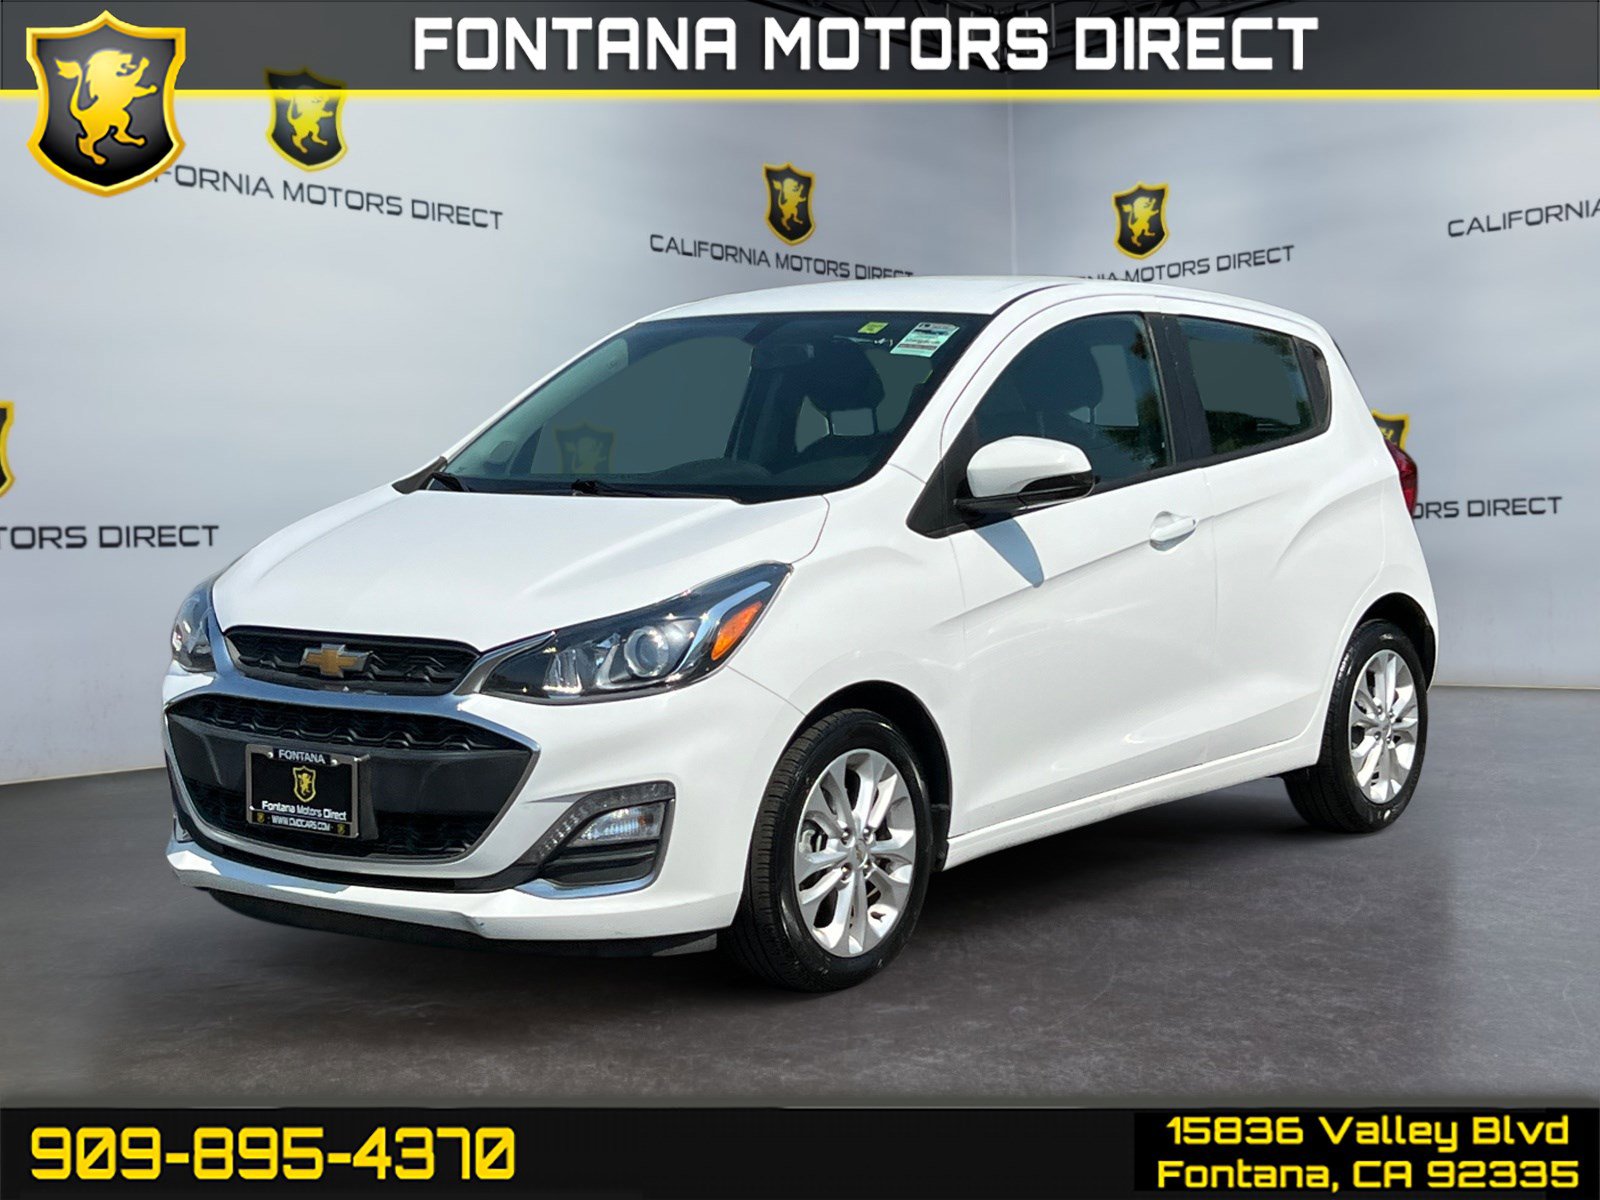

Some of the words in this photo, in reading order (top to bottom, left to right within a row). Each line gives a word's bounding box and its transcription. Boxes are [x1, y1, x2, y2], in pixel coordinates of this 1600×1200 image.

[283, 180, 403, 216] MOTORS
[411, 199, 503, 230] DIRECT
[650, 234, 771, 268] CALIFORNIA
[775, 252, 851, 278] MOTORS
[1125, 257, 1211, 283] MOTORS
[1216, 244, 1295, 272] DIRECT
[1466, 496, 1563, 518] DIRECT
[98, 525, 220, 549] DIRECT
[278, 749, 326, 764] FONTANA
[262, 800, 296, 814] Fontana
[296, 805, 322, 818] Motors
[323, 808, 347, 821] Direct
